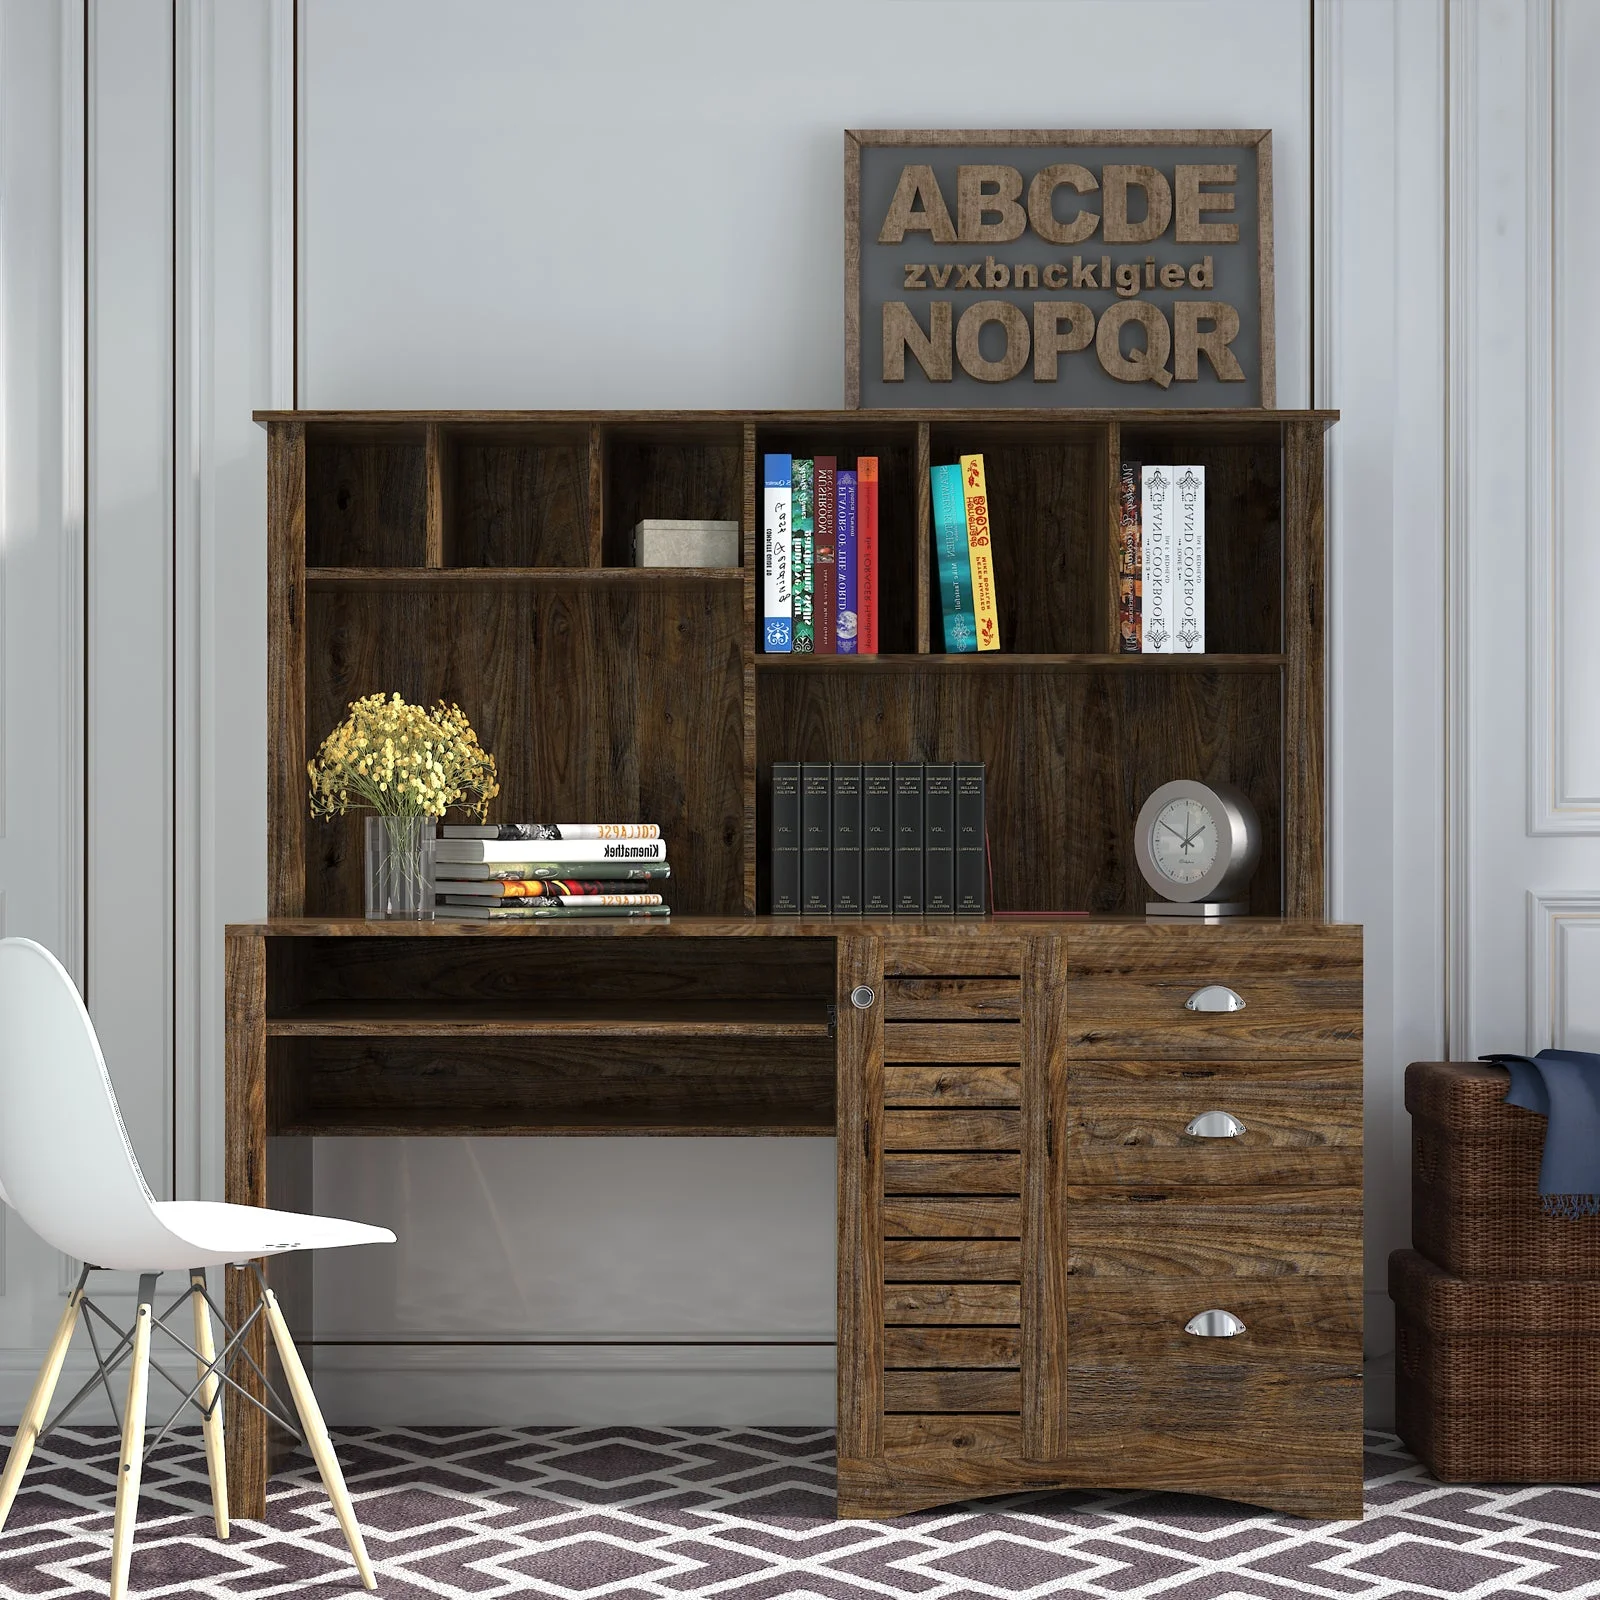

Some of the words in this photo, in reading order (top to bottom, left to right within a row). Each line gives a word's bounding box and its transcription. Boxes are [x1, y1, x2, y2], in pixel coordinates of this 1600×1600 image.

[877, 163, 1240, 246] ABCDE
[903, 255, 1215, 299] zvxbncklgied
[882, 300, 1247, 390] NOPQR
